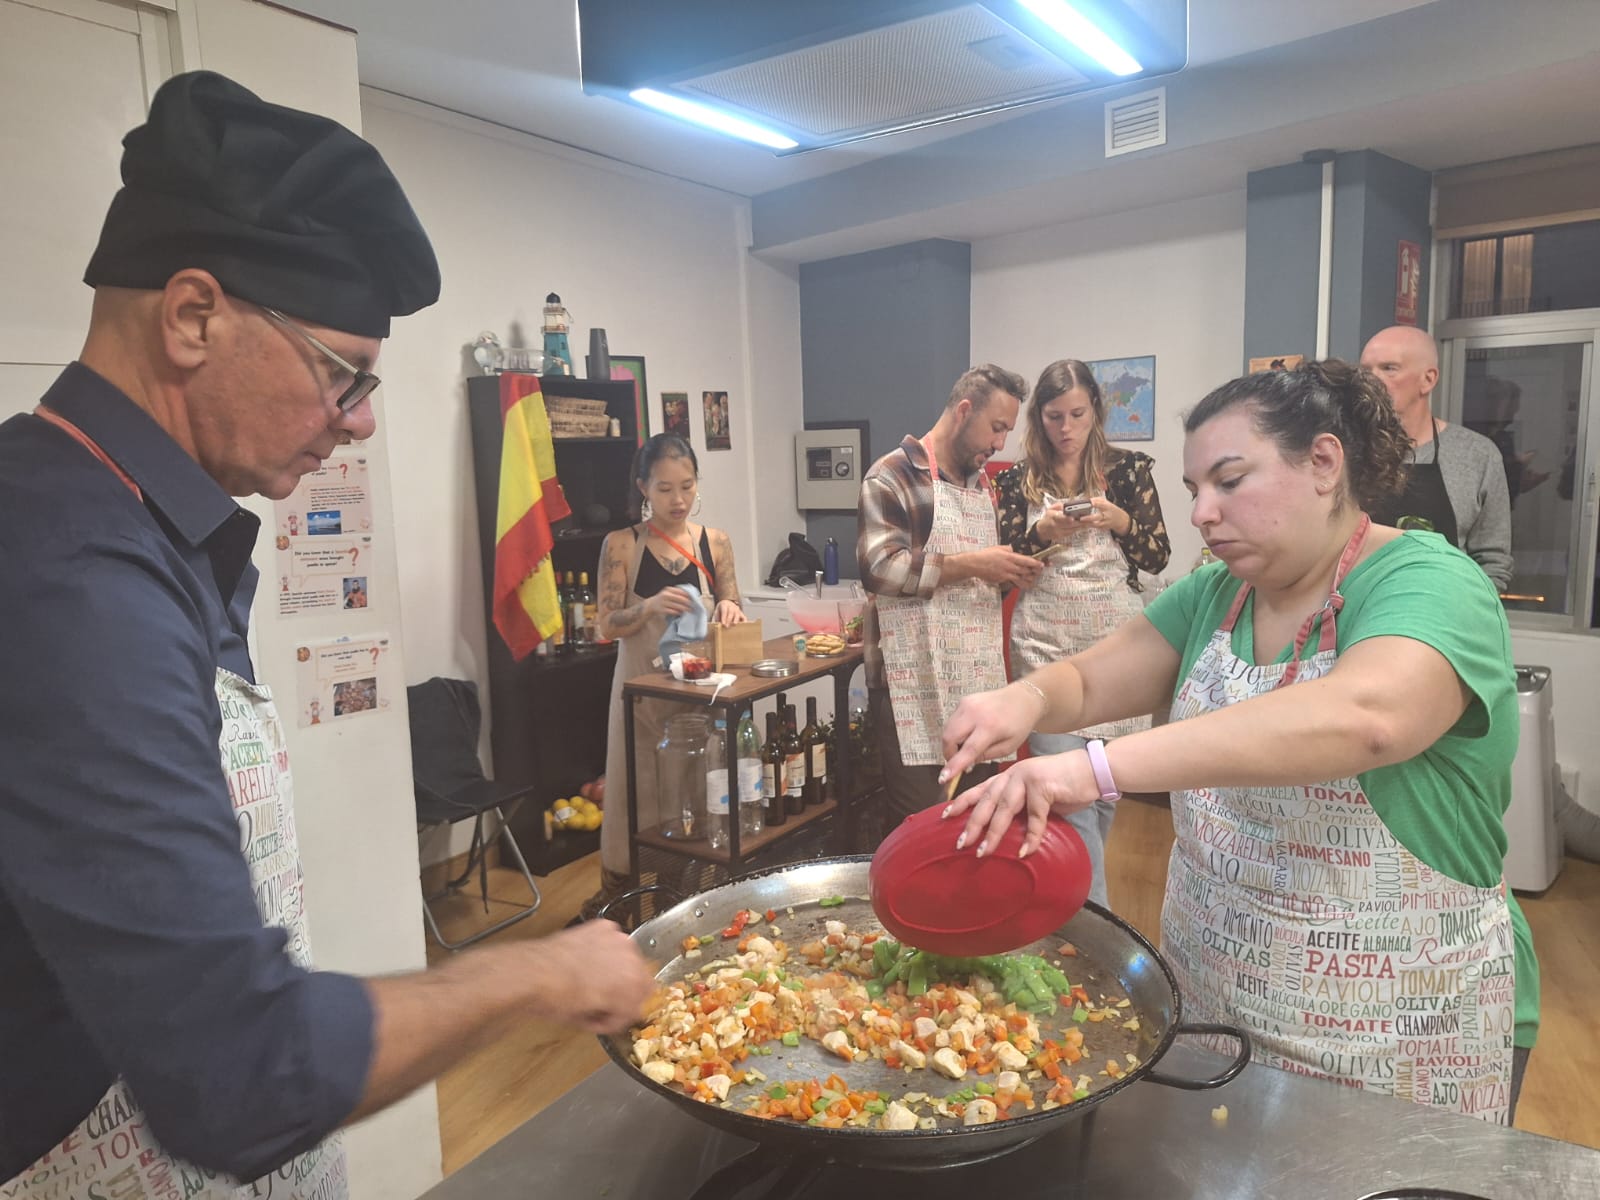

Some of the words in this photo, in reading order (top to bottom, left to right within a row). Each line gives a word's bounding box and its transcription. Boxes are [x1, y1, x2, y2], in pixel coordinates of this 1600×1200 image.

[1221, 657, 1262, 685] AJO
[1304, 787, 1367, 805] TOMA
[1194, 816, 1275, 865] MOZZARELLA
[1327, 825, 1397, 849] OLIVAS
[1288, 842, 1371, 868] PARMESANO
[1289, 859, 1369, 899] MOZZARELLA
[1359, 900, 1401, 913] RAVIOLI
[1402, 892, 1469, 911] PIMIENTO
[1223, 906, 1273, 950] PIMIENTO
[1401, 916, 1436, 936] AJO
[1439, 907, 1484, 947] TOMATE
[1202, 927, 1271, 968] OLIVAS
[1306, 930, 1361, 951] ACEITE
[1363, 935, 1412, 953] ALBAHACA
[1400, 930, 1494, 965] Ravioli
[1285, 943, 1303, 991] OLIVAS
[1304, 949, 1396, 979] PASTA
[1203, 972, 1231, 1002] AJO
[1236, 972, 1268, 1000] ACEITE
[1302, 975, 1395, 1004] RAVIOLI
[1399, 969, 1465, 996] TOMATE
[1271, 988, 1315, 1012] RÚCULA
[1320, 1000, 1392, 1018] OREGANO
[1395, 995, 1461, 1012] OLIVAS
[1462, 964, 1479, 1040] PIMIENTO
[1301, 1011, 1392, 1033] TOMATE
[1323, 1031, 1388, 1044] RAVIOLI
[1397, 1036, 1460, 1056] TOMATE
[1321, 1051, 1394, 1079] OLIVAS
[1416, 1056, 1480, 1067] RAVIOLI
[1433, 1082, 1458, 1105] AJO
